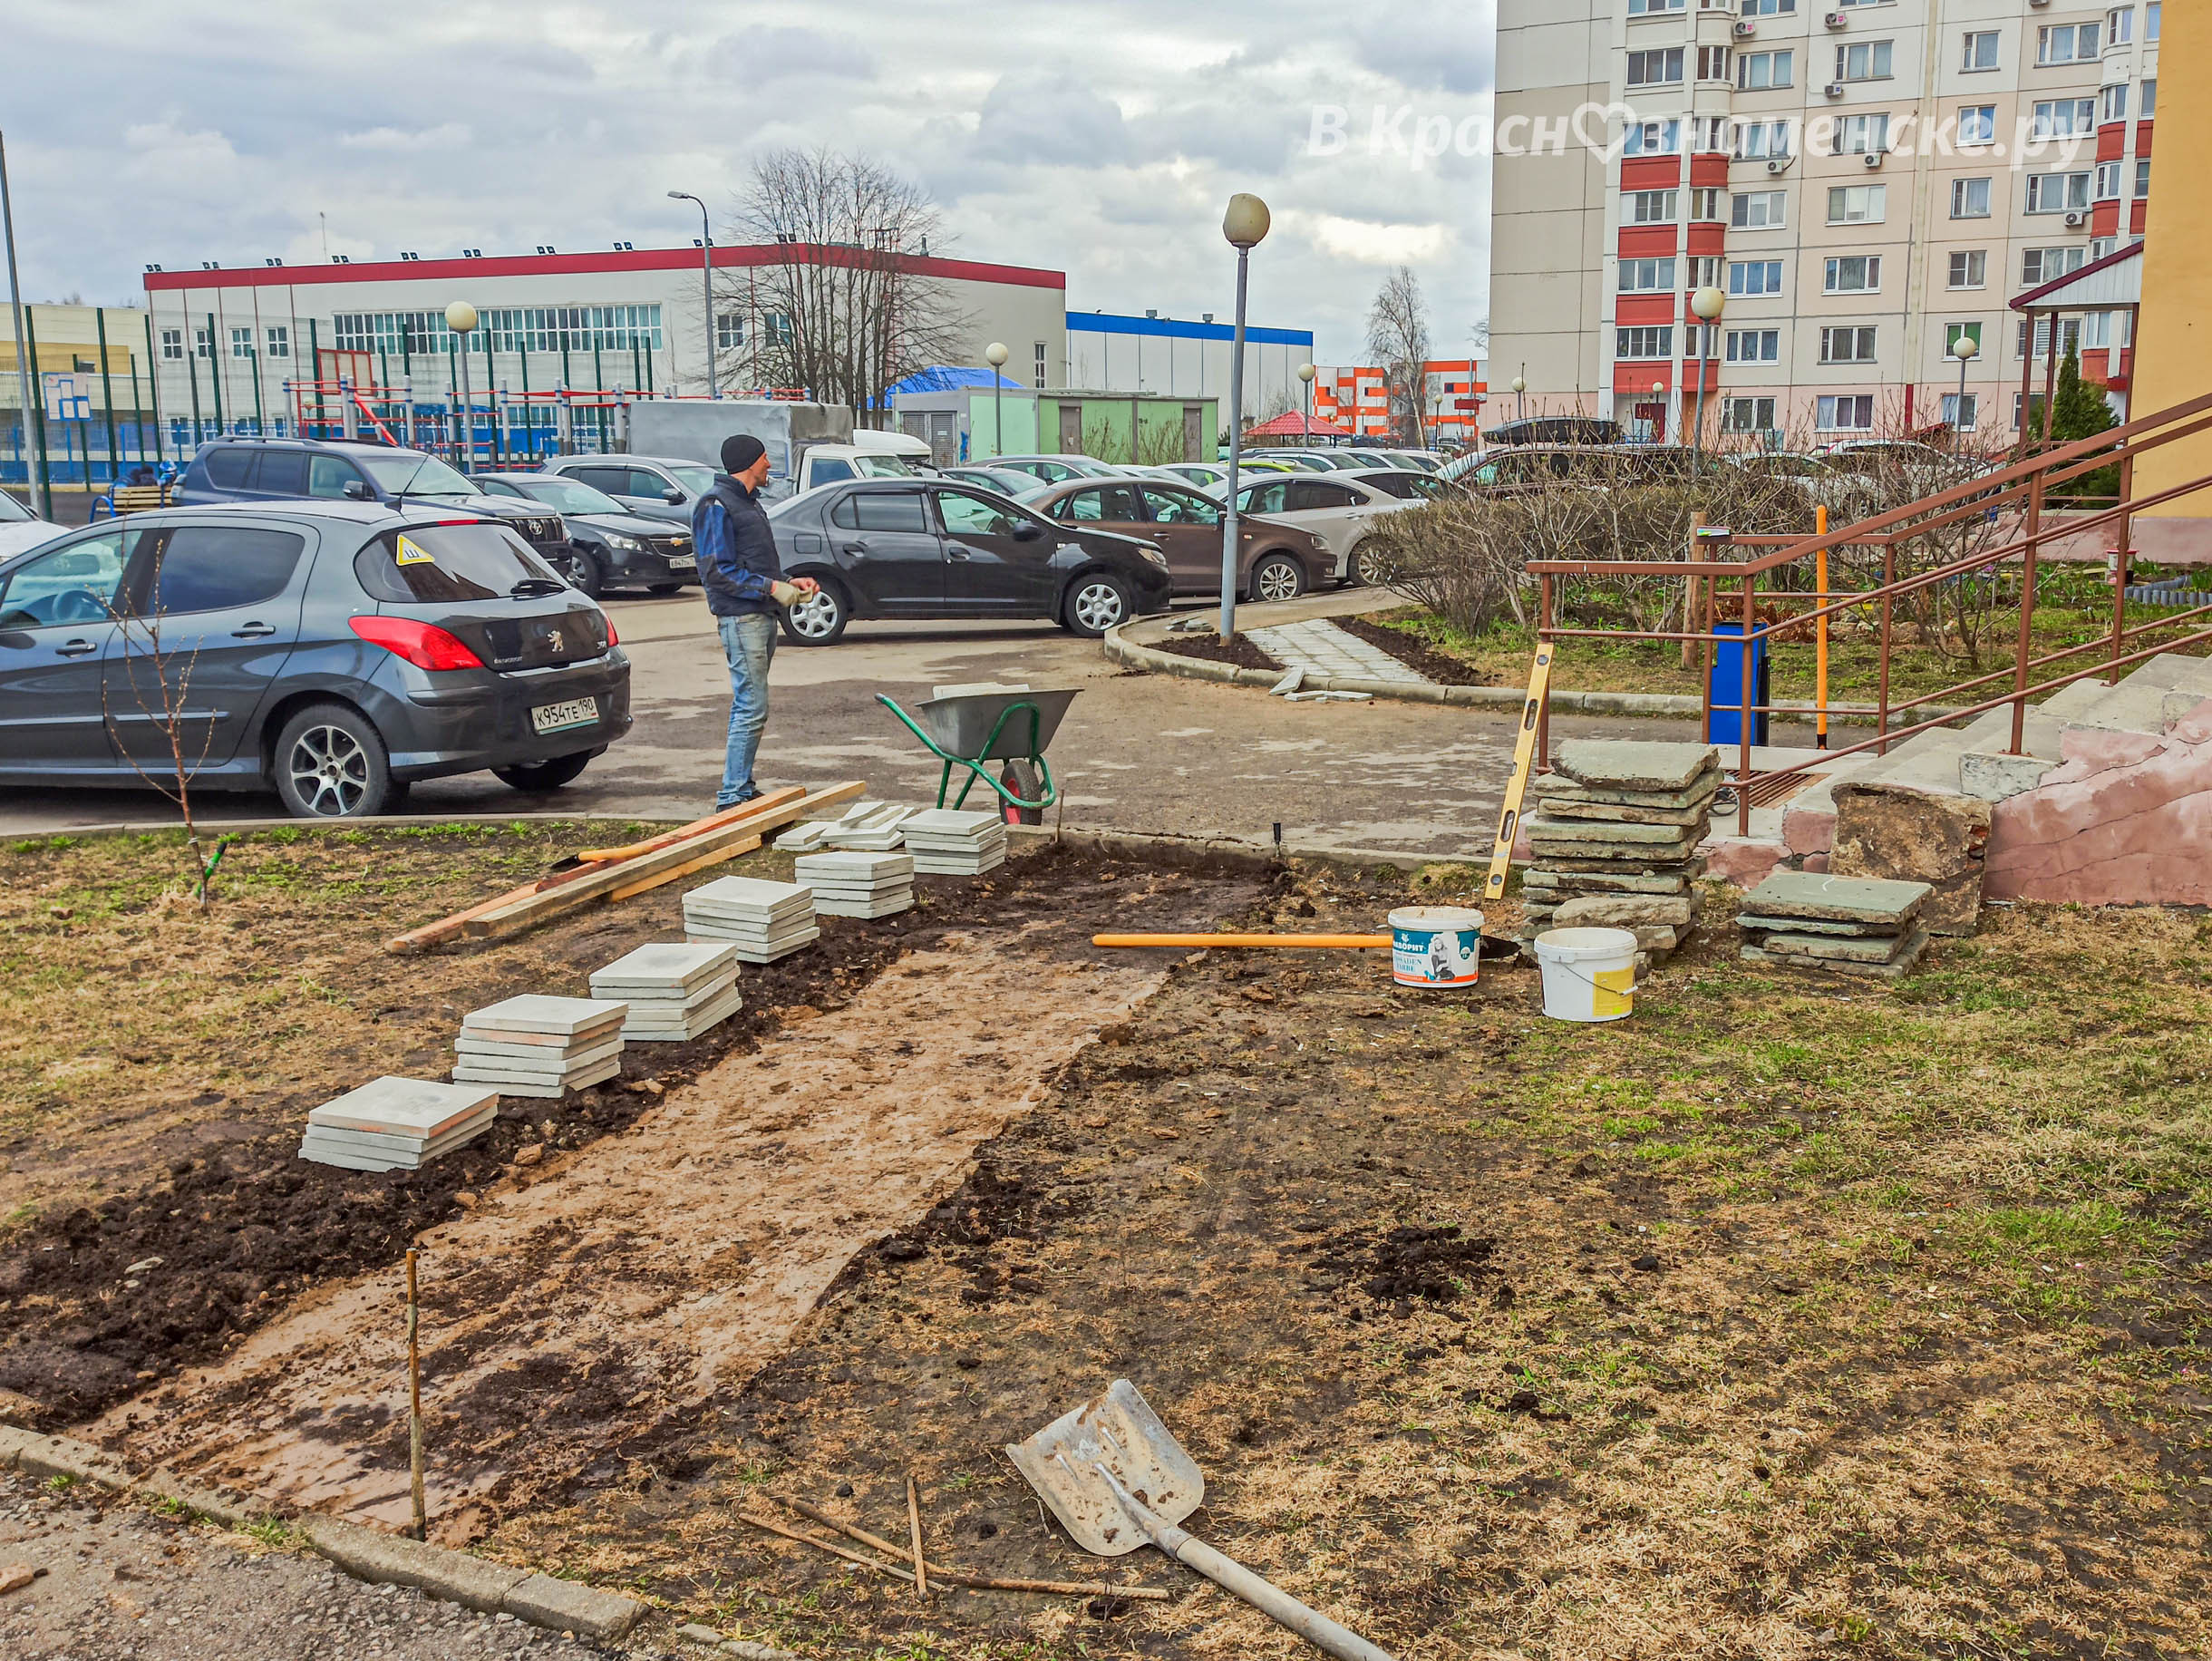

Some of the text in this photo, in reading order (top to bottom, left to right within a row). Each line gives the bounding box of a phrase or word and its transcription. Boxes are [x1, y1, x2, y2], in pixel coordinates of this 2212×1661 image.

[404, 549, 420, 559] Ш
[536, 698, 594, 726] К954ТЕ 190
